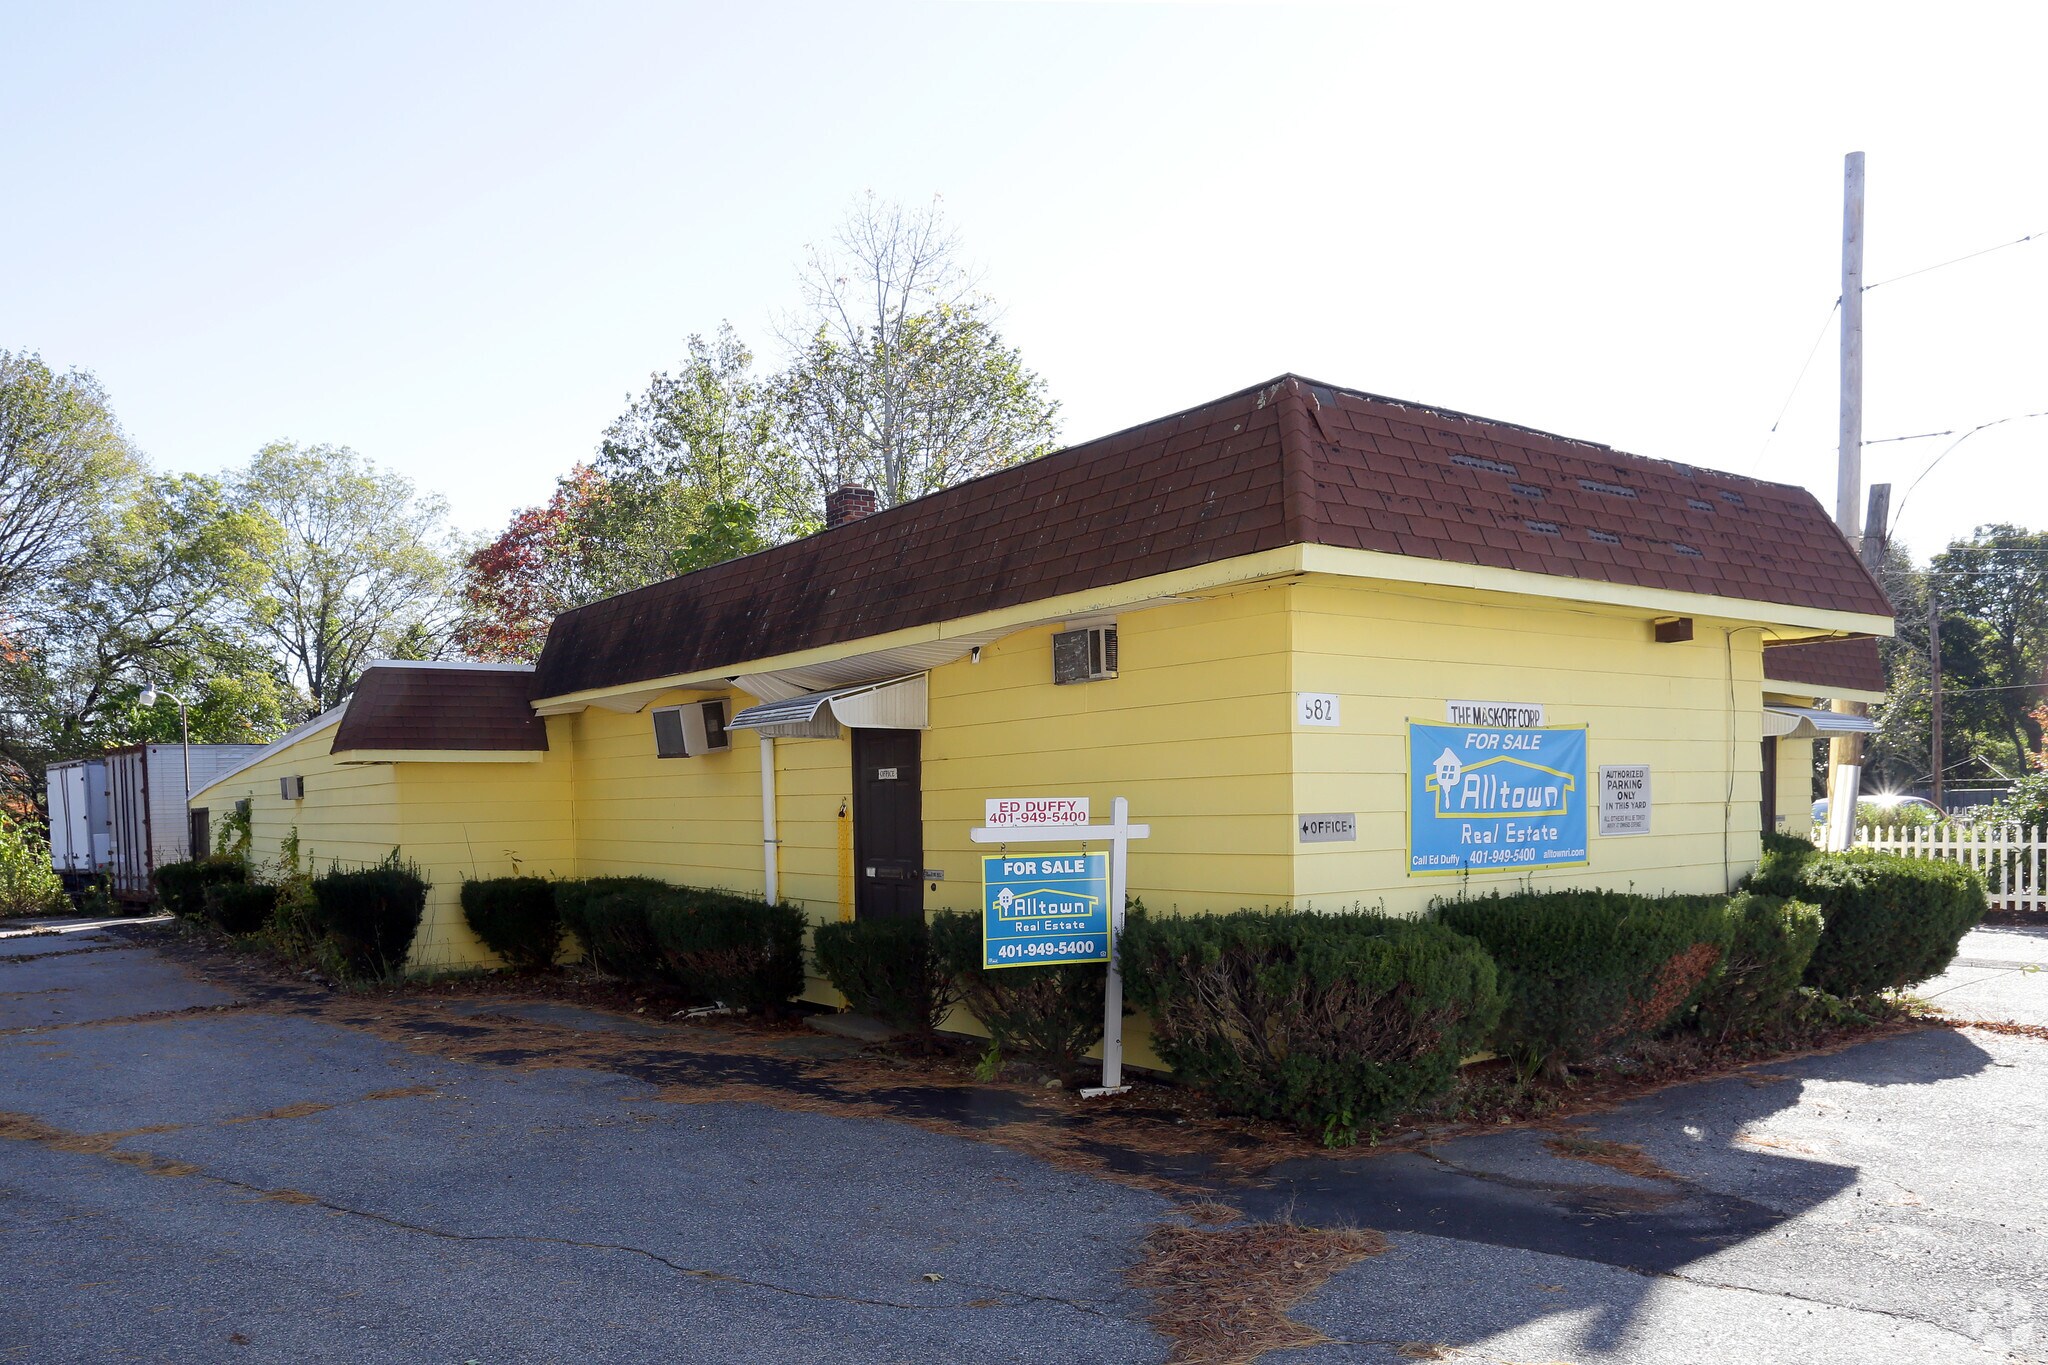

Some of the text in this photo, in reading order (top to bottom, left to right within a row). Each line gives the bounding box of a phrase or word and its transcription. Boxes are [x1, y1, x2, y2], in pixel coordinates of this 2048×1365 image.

[1305, 699, 1332, 721] 582
[1518, 708, 1540, 728] CORP
[1464, 733, 1542, 750] FOR SALE
[1606, 770, 1644, 779] AUTHORIZED
[1460, 773, 1558, 810] Alltown
[1607, 779, 1643, 790] PARKING
[1617, 791, 1636, 800] ONLY
[999, 800, 1077, 813] ED DUFFY
[1605, 801, 1646, 810] IN THIS YARD
[989, 811, 1086, 823] 401-949-5400
[1310, 821, 1347, 834] OFFICE
[1461, 822, 1558, 844] Real Estate
[1412, 854, 1460, 866] Call Ed Duffy
[1469, 848, 1535, 864] 401-949-5400
[1003, 859, 1085, 876] FOR SALE
[1014, 898, 1084, 916] Alltown
[1015, 920, 1085, 932] Real Estate
[998, 940, 1095, 958] 401-949-5400
